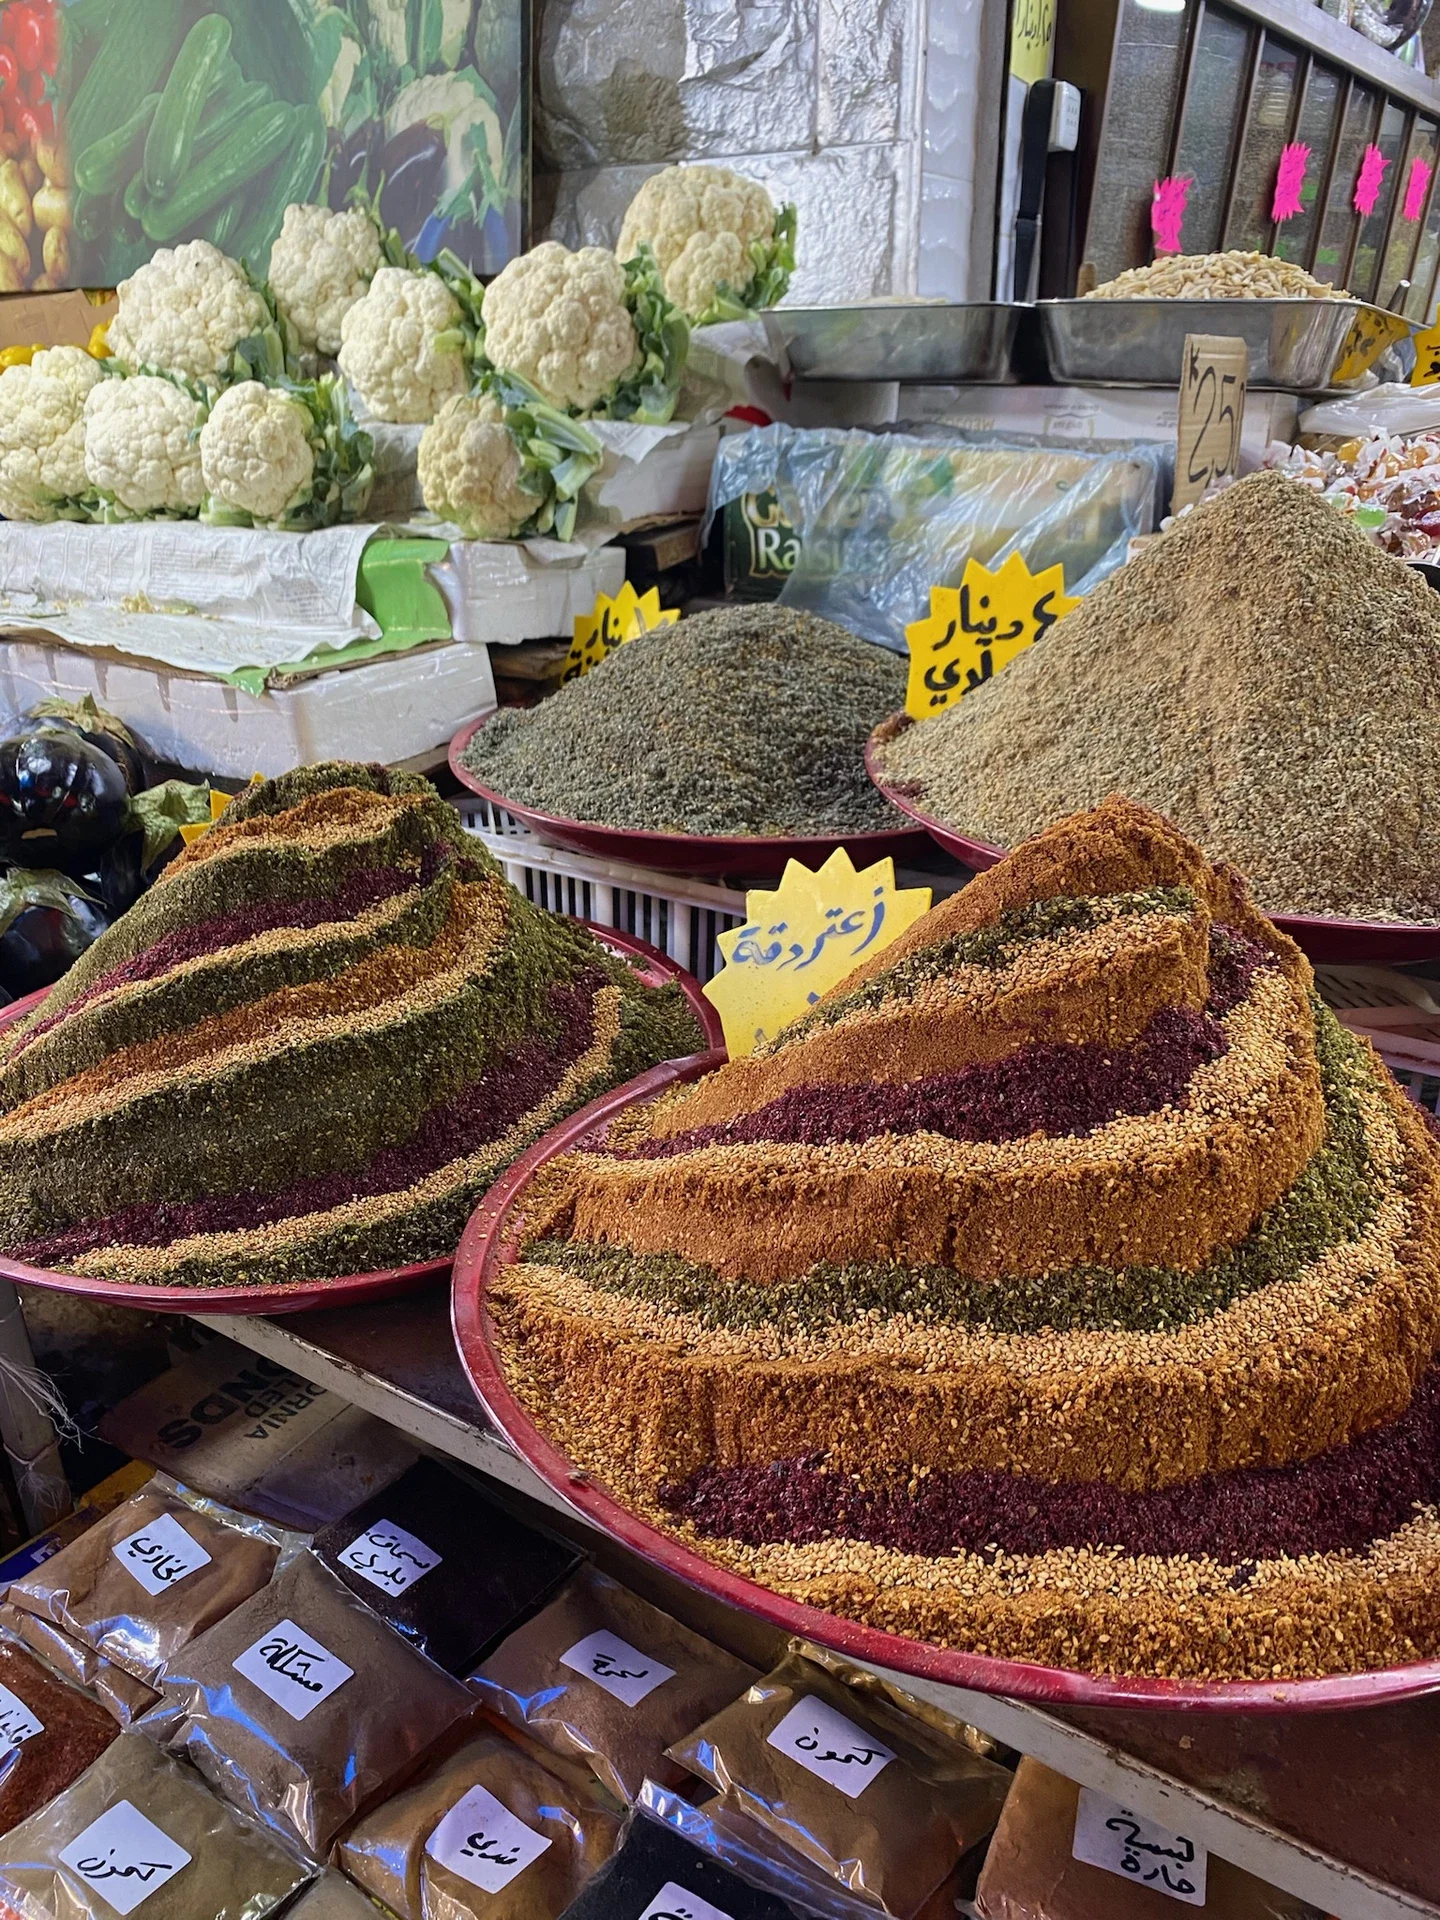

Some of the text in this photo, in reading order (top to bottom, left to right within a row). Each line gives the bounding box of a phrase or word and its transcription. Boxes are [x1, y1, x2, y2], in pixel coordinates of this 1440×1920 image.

[932, 584, 1024, 651] دينار
[923, 649, 994, 707] لدي
[731, 886, 886, 971] زعتر دقة
[127, 1537, 188, 1583] بخاري
[349, 1551, 407, 1586] بلدي
[794, 1726, 887, 1766] كمون
[77, 1848, 173, 1881] كمون
